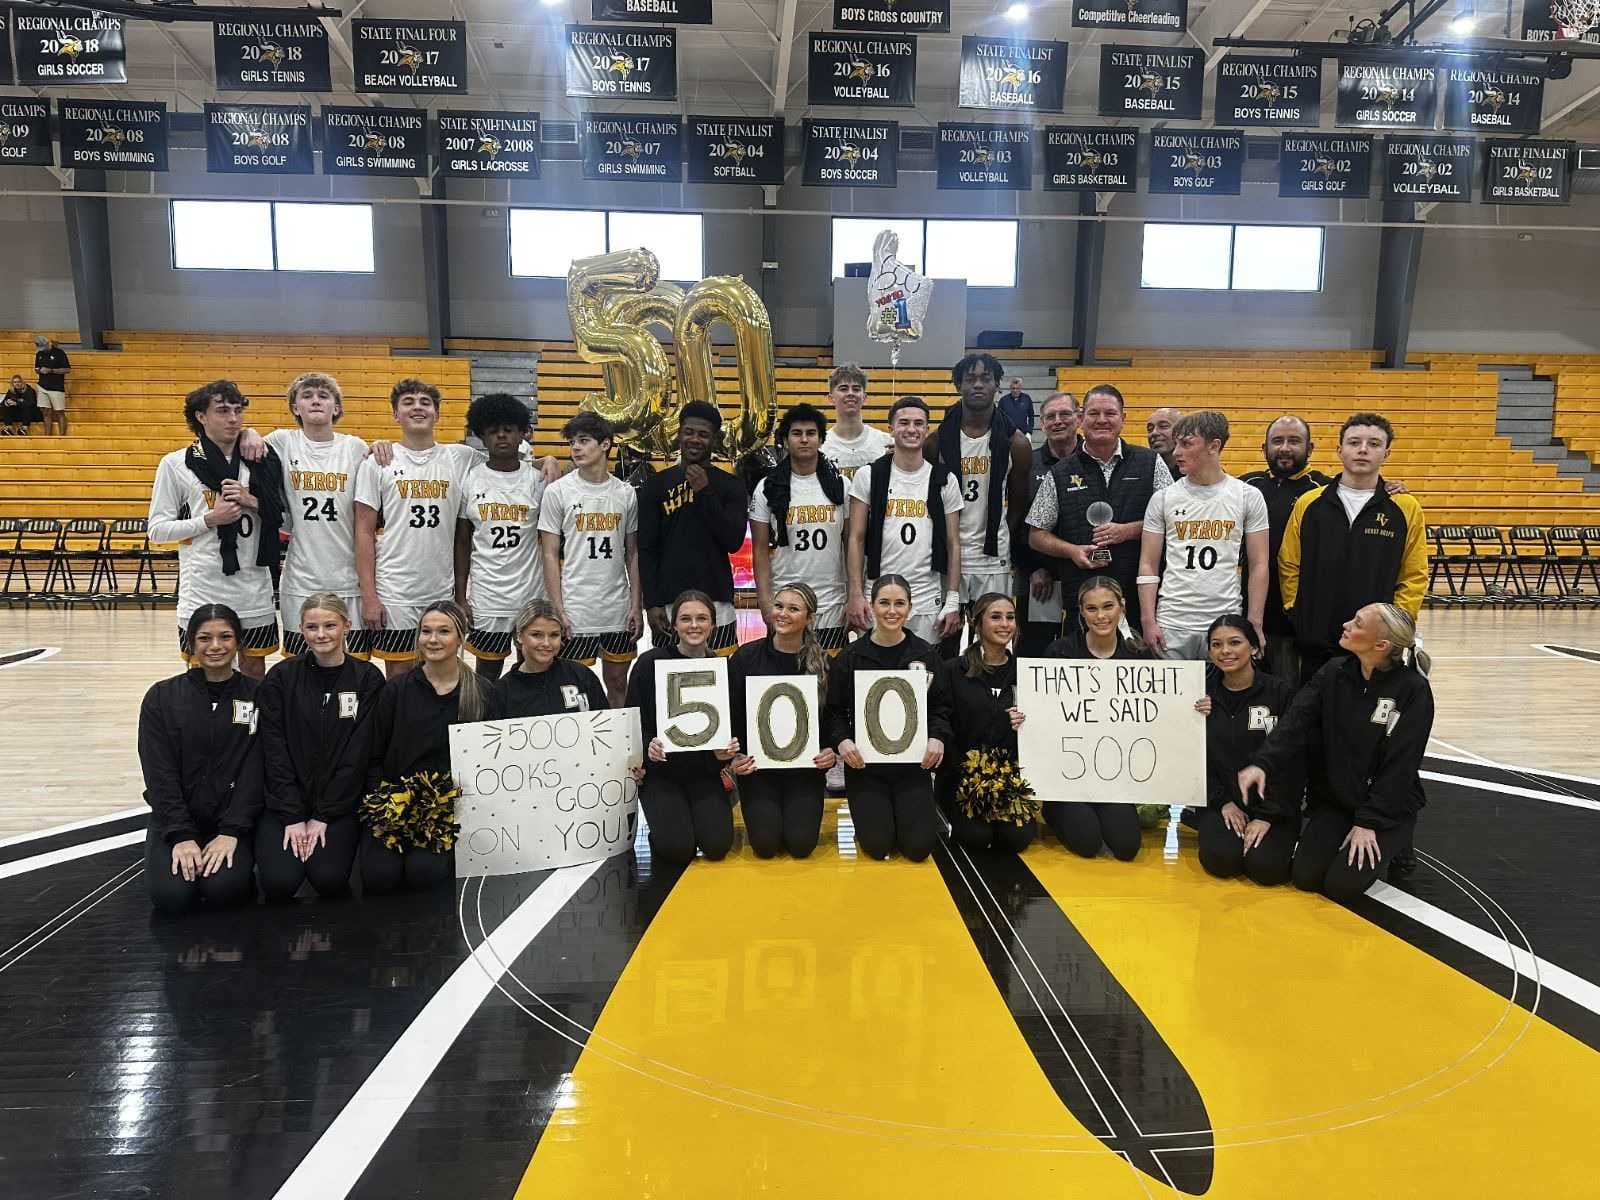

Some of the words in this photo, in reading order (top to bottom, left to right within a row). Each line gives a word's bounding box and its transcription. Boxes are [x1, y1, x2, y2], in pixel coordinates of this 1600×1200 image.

[627, 0, 678, 13] BASEBALL
[841, 8, 865, 20] BOYS
[868, 10, 896, 22] CROSS
[901, 10, 943, 23] COUNTRY
[1079, 9, 1126, 24] Competitive
[1128, 10, 1180, 27] Cheerleading
[18, 17, 72, 31] REGIONAL
[75, 17, 121, 31] CHAMPS
[218, 23, 273, 37] REGIONAL
[275, 24, 323, 37] CHAMPS
[361, 26, 392, 40] STATE
[396, 27, 427, 41] FINAL
[429, 28, 457, 41] FOUR
[571, 31, 625, 46] REGIONAL
[626, 33, 672, 48] CHAMPS
[1527, 29, 1549, 40] BOYS
[241, 46, 260, 60] 20
[287, 46, 302, 61] 18
[814, 39, 865, 53] REGIONAL
[867, 41, 912, 56] CHAMPS
[977, 44, 1005, 59] STATE
[1009, 45, 1053, 60] FINALIST
[592, 56, 610, 70] 20
[636, 57, 649, 71] 17
[1112, 53, 1142, 66] STATE
[1146, 54, 1193, 68] FINALIST
[38, 64, 63, 76] GIRLS
[67, 63, 104, 75] SOCCER
[241, 71, 268, 82] GIRLS
[271, 71, 305, 82] TENNIS
[986, 68, 1003, 82] 20
[1027, 70, 1040, 83] 16
[1223, 63, 1272, 77] REGIONAL
[1273, 65, 1317, 78] CHAMPS
[1344, 66, 1391, 80] REGIONAL
[1392, 67, 1435, 81] CHAMPS
[365, 74, 396, 86] BEACH
[400, 75, 458, 88] VOLLEYBALL
[1451, 69, 1499, 83] REGIONAL
[1500, 72, 1540, 85] CHAMPS
[592, 80, 616, 92] BOYS
[620, 81, 651, 92] TENNIS
[834, 86, 889, 99] VOLLEYBALL
[1240, 84, 1257, 98] 20
[1282, 85, 1297, 99] 15
[990, 92, 1034, 104] BASEBALL
[1125, 98, 1175, 110] BASEBALL
[1468, 91, 1483, 104] 20
[1508, 93, 1520, 106] 14
[2, 104, 46, 118] CHAMPS
[65, 107, 114, 121] REGIONAL
[116, 109, 160, 122] CHAMPS
[1235, 108, 1260, 119] BOYS
[1264, 108, 1300, 119] TENNIS
[1356, 110, 1379, 121] GIRLS
[1382, 111, 1416, 122] SOCCER
[211, 112, 261, 125] REGIONAL
[263, 113, 306, 126] CHAMPS
[328, 114, 376, 127] REGIONAL
[377, 115, 422, 129] CHAMPS
[440, 117, 468, 130] STATE
[470, 118, 538, 132] SEMI-FINALIST
[1471, 114, 1511, 126] BASEBALL
[13, 125, 29, 138] 09
[586, 121, 633, 134] REGIONAL
[635, 122, 677, 135] CHAMPS
[696, 124, 726, 136] STATE
[728, 125, 773, 137] FINALIST
[812, 126, 842, 138] STATE
[843, 127, 889, 140] FINALIST
[232, 132, 249, 145] 20
[272, 133, 289, 145] 08
[941, 130, 985, 143] REGIONAL
[988, 130, 1029, 143] CHAMPS
[1048, 132, 1093, 145] REGIONAL
[1095, 133, 1135, 145] CHAMPS
[1154, 137, 1199, 150] REGIONAL
[1200, 137, 1240, 150] CHAMPS
[2, 147, 27, 157] GOLF
[446, 138, 474, 151] 2007
[504, 139, 534, 152] 2008
[606, 142, 622, 154] 20
[644, 142, 660, 155] 07
[1285, 140, 1330, 152] REGIONAL
[1331, 140, 1369, 153] CHAMPS
[1388, 144, 1432, 156] REGIONAL
[1433, 145, 1470, 157] CHAMPS
[74, 151, 101, 161] BOYS
[104, 152, 154, 163] SWIMMING
[234, 155, 259, 165] BOYS
[262, 156, 286, 165] GOLF
[824, 147, 840, 160] 20
[862, 148, 878, 161] 04
[1066, 153, 1082, 165] 20
[1103, 153, 1118, 166] 03
[1491, 147, 1520, 158] STATE
[1522, 147, 1567, 160] FINALIST
[336, 157, 364, 167] GIRLS
[367, 158, 415, 168] SWIMMING
[451, 160, 477, 170] GIRLS
[480, 161, 528, 172] LACROSSE
[599, 164, 622, 174] GIRLS
[624, 164, 666, 175] SWIMMING
[1300, 160, 1315, 172] 20
[1336, 160, 1351, 172] 02
[714, 166, 756, 177] SOFTBALL
[821, 169, 842, 179] BOYS
[845, 170, 878, 180] SOCCER
[959, 172, 1008, 183] VOLLEYBALL
[1503, 167, 1518, 179] 20
[1538, 167, 1552, 179] 02
[1053, 174, 1075, 185] GIRLS
[1078, 175, 1127, 185] BASKETBALL
[1174, 177, 1193, 187] BOYS
[1195, 177, 1214, 188] GOLF
[1302, 180, 1323, 191] GIRLS
[1326, 181, 1346, 191] GOLF
[1393, 184, 1460, 195] VOLLEYBALL
[1493, 186, 1512, 196] GIRLS
[1514, 187, 1560, 197] BASKETBALL
[880, 298, 911, 329] #1
[289, 471, 348, 492] VEROT
[396, 480, 449, 499] VEROT
[964, 480, 979, 502] 3
[303, 497, 338, 521] 24
[478, 503, 529, 522] VEROT
[785, 505, 836, 525] VEROT
[884, 499, 929, 517] VERO
[409, 505, 440, 529] 33
[575, 513, 622, 531] VEROT
[900, 522, 916, 545] 0
[1174, 520, 1235, 540] VEROT
[490, 526, 521, 549] 25
[794, 529, 827, 551] 30
[587, 537, 613, 559] 14
[1185, 546, 1217, 570] 10
[1029, 665, 1101, 695] THAT'S
[664, 670, 720, 747] 5
[864, 676, 918, 755] 0
[1061, 699, 1099, 722] WE
[1110, 698, 1159, 722] SAID
[758, 682, 809, 762] 0
[508, 717, 580, 751] 500
[1061, 736, 1157, 782] 500
[458, 759, 562, 796] LOOKS
[556, 777, 638, 812] GOOD
[469, 824, 520, 855] ON
[555, 812, 636, 852] YOU!
